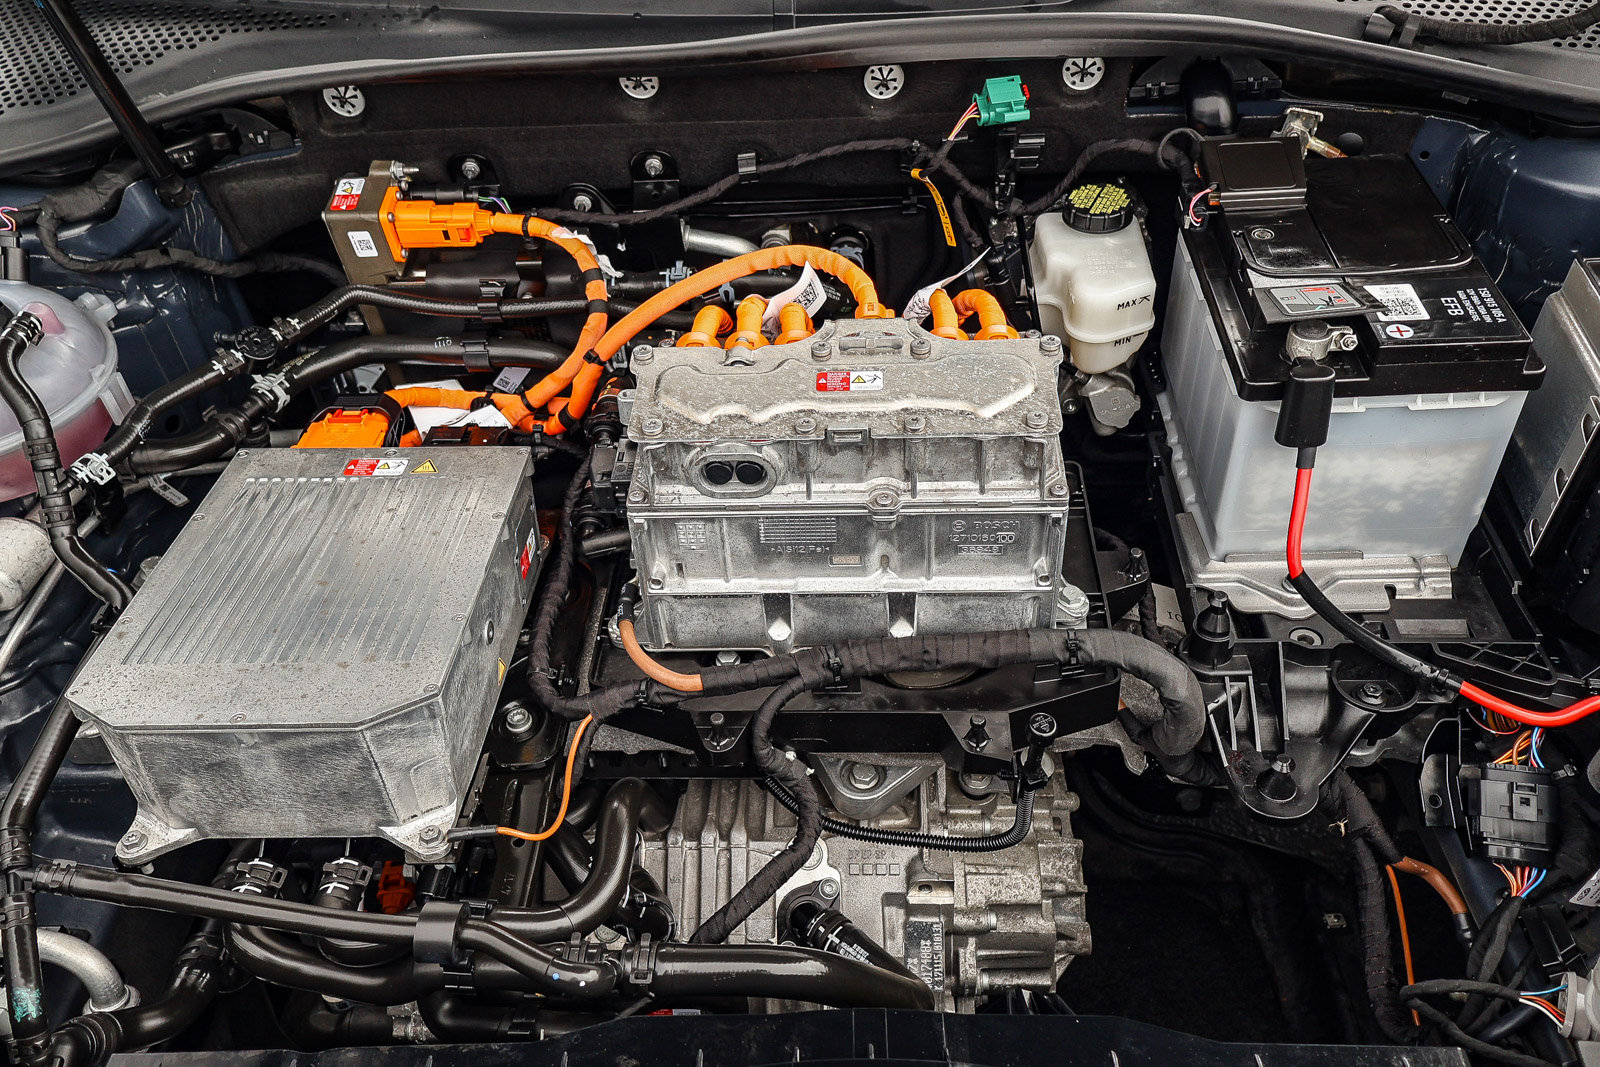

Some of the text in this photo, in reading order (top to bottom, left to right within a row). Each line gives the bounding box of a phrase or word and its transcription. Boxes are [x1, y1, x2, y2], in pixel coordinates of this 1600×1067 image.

[1117, 299, 1137, 310] MAX
[1440, 297, 1465, 316] EFB
[1114, 336, 1132, 347] MIN
[973, 521, 1020, 530] BOSCH
